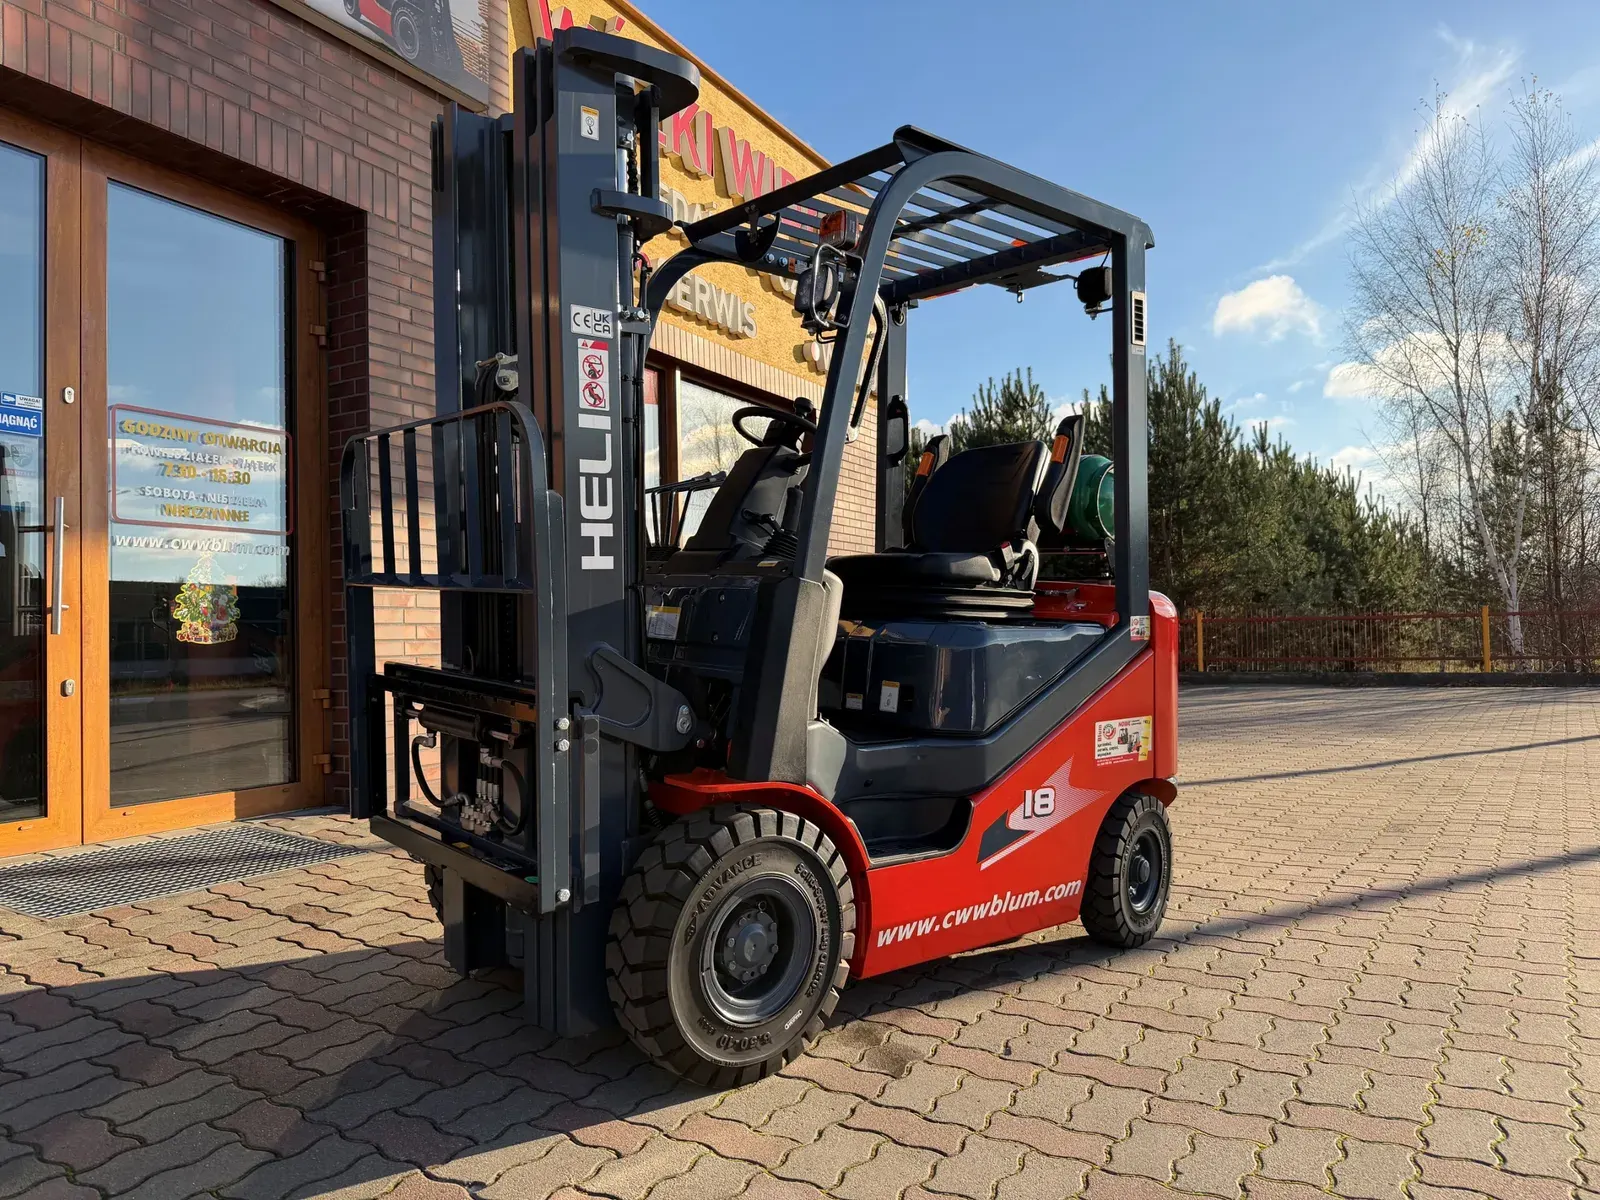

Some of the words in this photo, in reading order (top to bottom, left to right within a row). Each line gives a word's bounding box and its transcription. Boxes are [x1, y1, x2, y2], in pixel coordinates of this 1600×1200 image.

[593, 312, 609, 324] UK
[665, 273, 758, 338] ERWIS
[593, 323, 611, 334] CA
[121, 419, 199, 443] GODZINY
[203, 431, 283, 455] OTWARCIA
[143, 485, 197, 500] SOBOTA
[578, 413, 614, 570] HELI
[1023, 787, 1055, 819] 18
[697, 853, 762, 915] ADVANCE
[877, 879, 1082, 948] www.cwwblum.com
